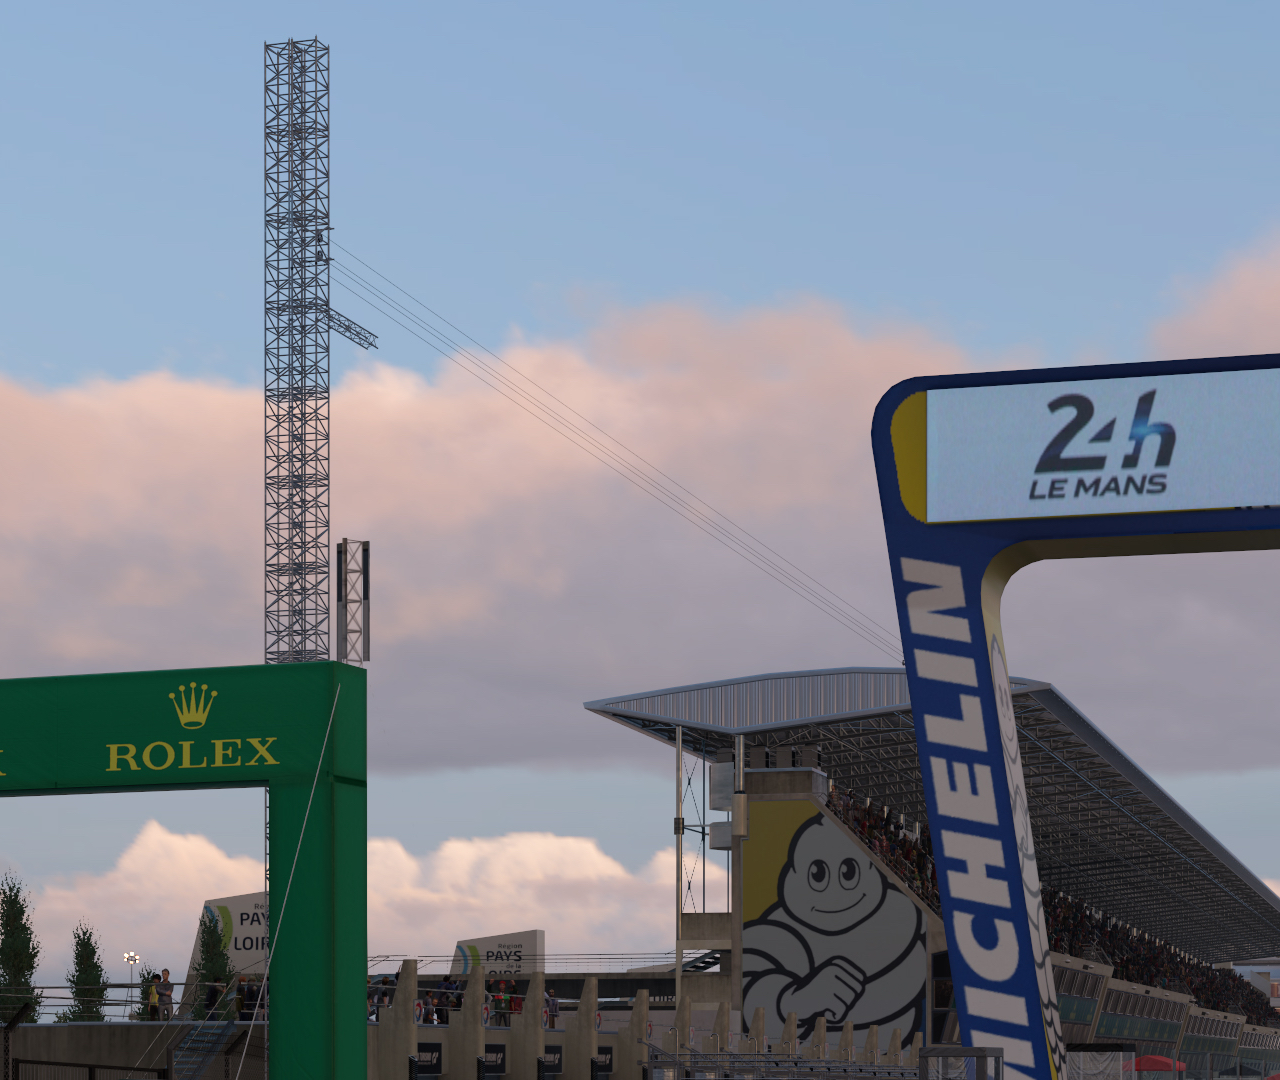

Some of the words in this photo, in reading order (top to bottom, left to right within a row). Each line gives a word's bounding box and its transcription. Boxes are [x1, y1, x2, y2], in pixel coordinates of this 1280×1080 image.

[1033, 388, 1177, 474] 24h
[1029, 479, 1068, 501] LE
[1073, 472, 1167, 499] MANS
[106, 737, 280, 771] ROLEX
[234, 937, 269, 950] LOIR
[486, 951, 522, 961] PAYS
